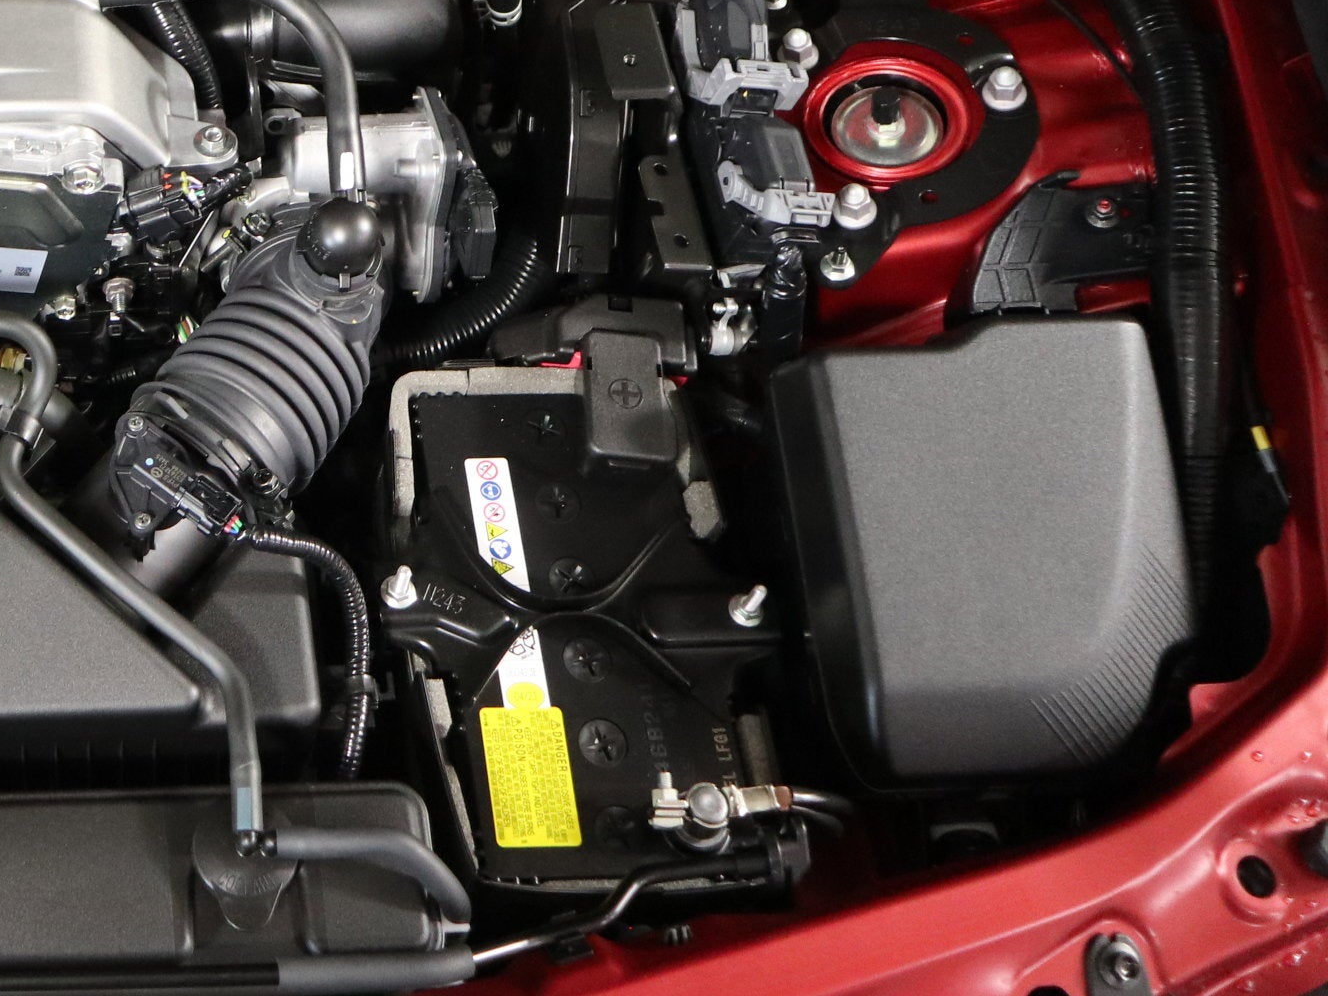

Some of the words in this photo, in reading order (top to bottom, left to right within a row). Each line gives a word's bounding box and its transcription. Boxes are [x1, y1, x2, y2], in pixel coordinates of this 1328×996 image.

[514, 728, 526, 762] POISON
[552, 731, 568, 772] DANGER
[500, 798, 511, 828] CHILDREN
